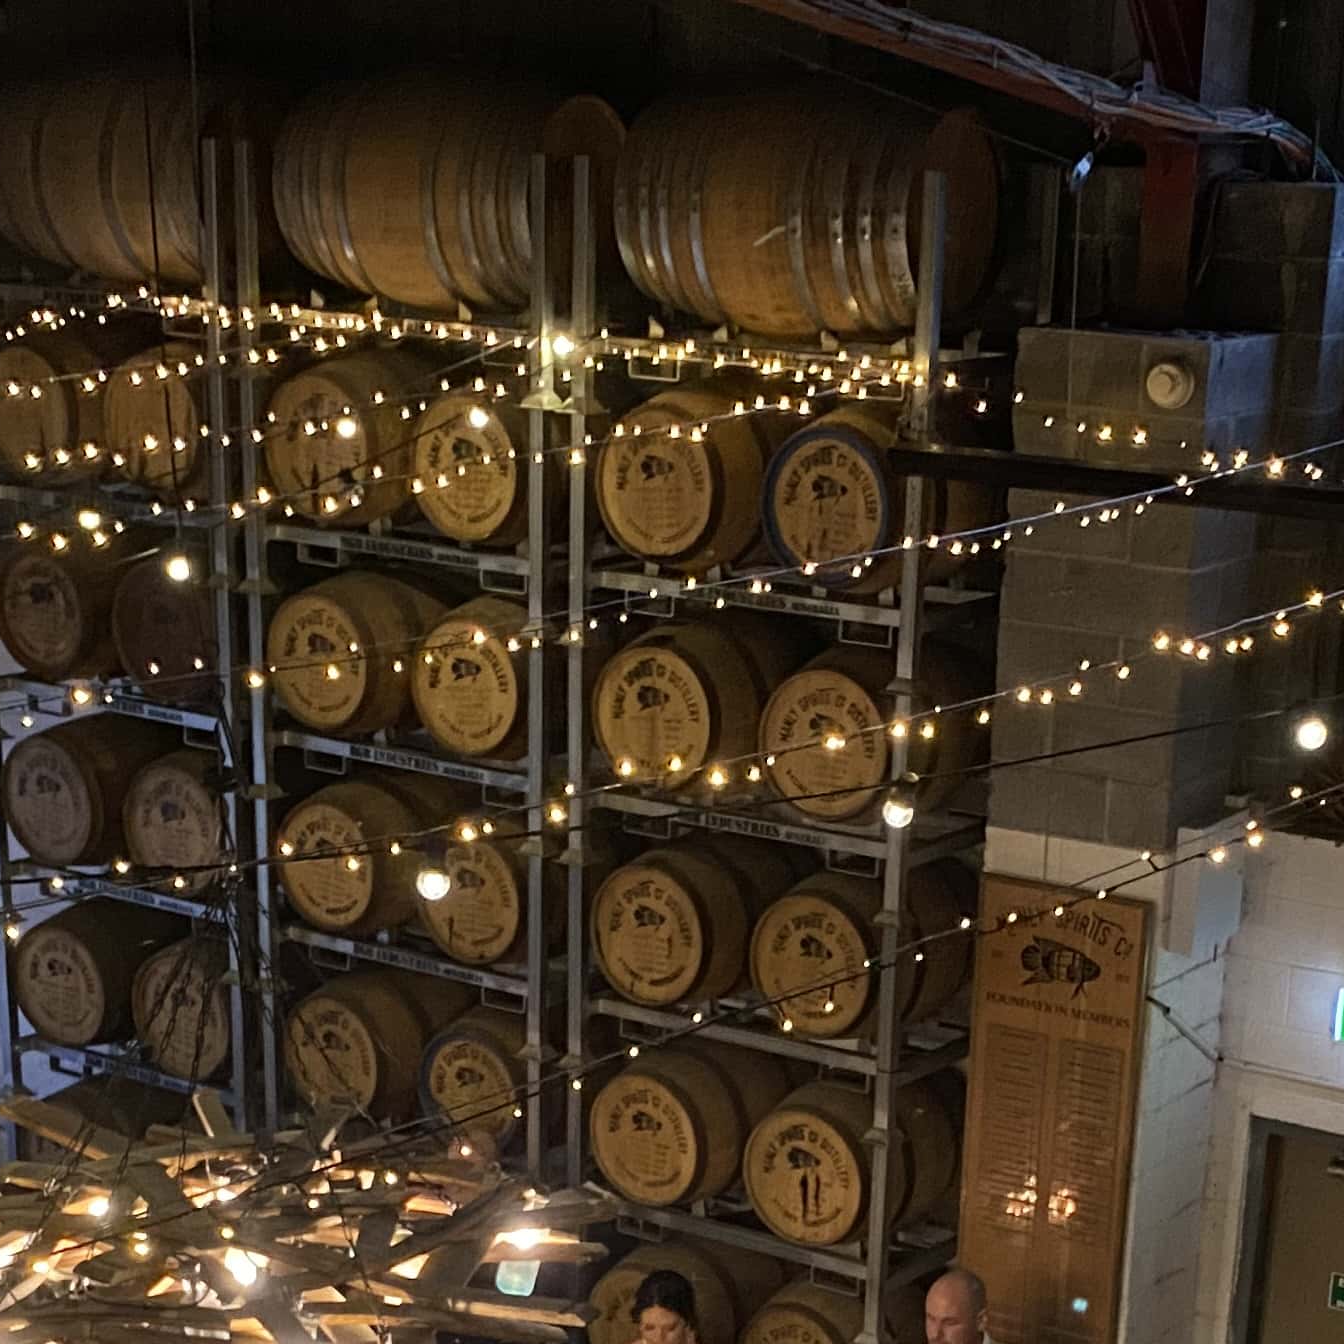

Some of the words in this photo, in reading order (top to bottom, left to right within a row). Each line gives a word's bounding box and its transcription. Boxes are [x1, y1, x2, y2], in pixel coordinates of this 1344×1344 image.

[1056, 908, 1125, 946] SPIRITS
[986, 991, 1067, 1015] FOUNDATION
[1071, 1007, 1130, 1027] MEMBERS
